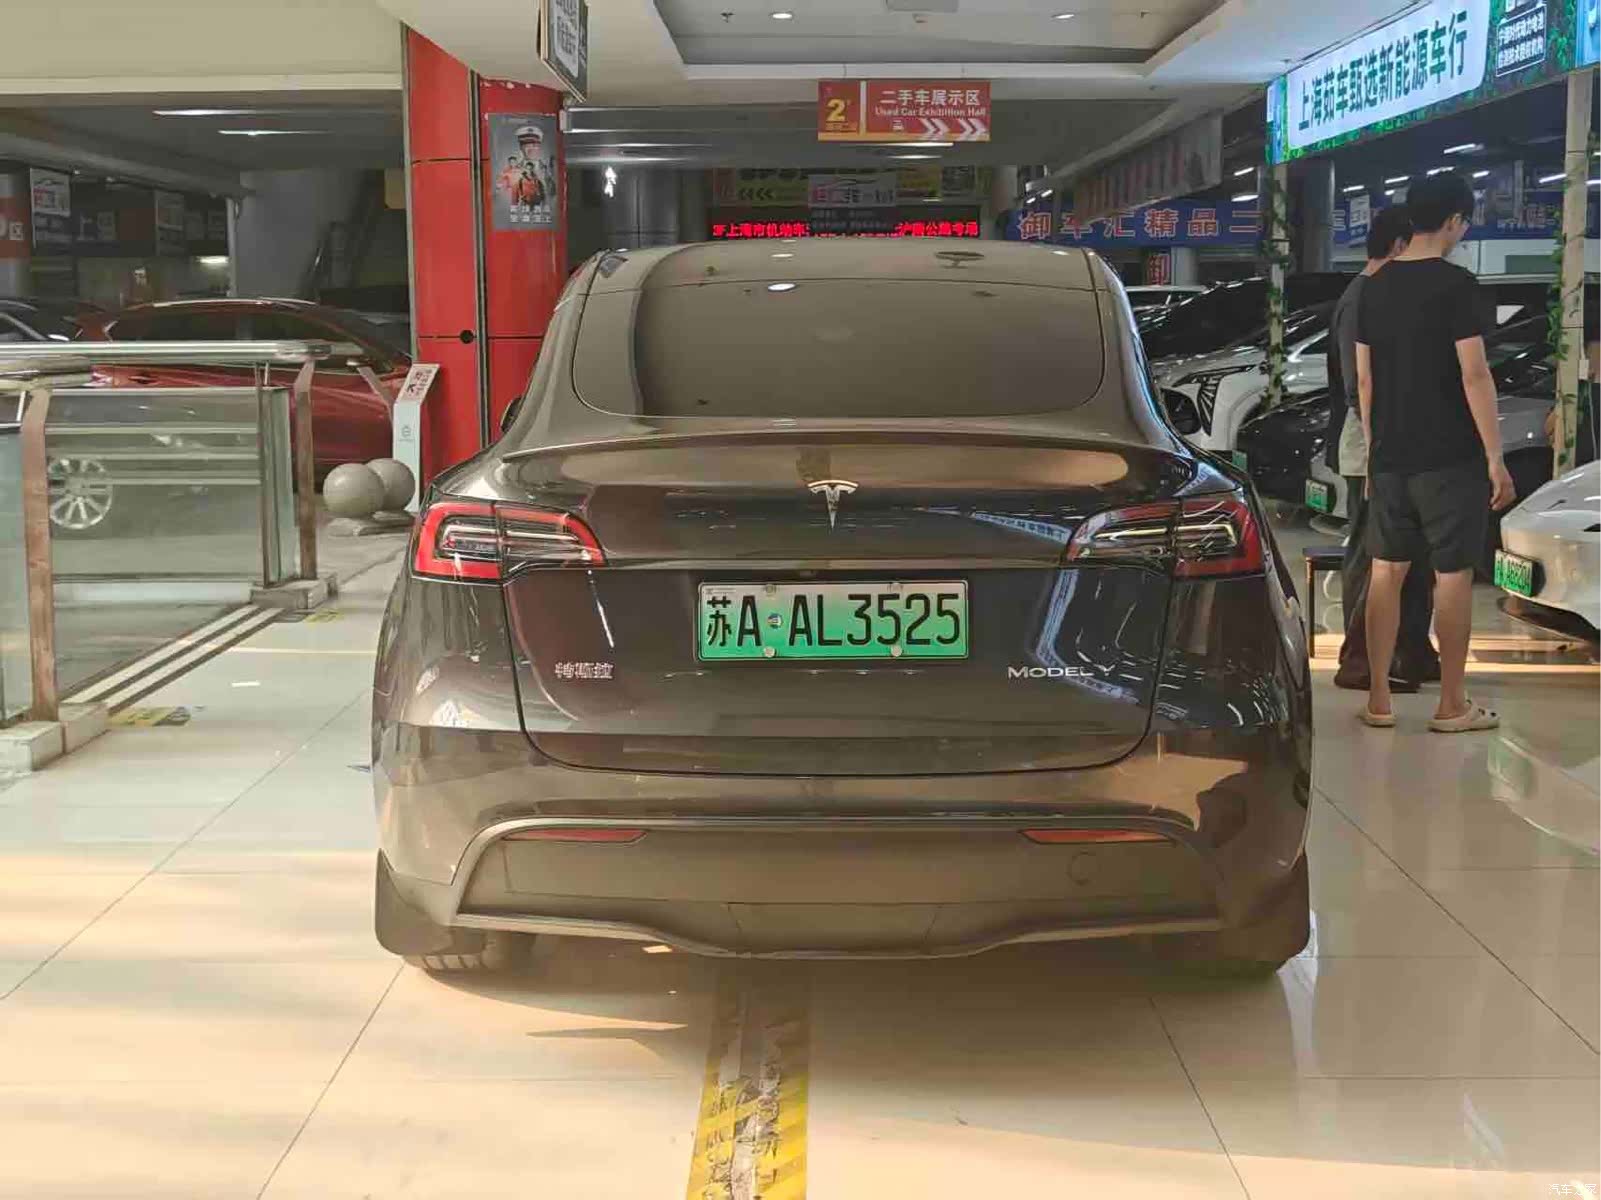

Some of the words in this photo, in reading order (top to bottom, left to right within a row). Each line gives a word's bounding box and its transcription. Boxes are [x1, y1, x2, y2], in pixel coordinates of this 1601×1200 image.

[879, 89, 981, 106] 二手车展示区
[875, 106, 898, 116] Used
[901, 106, 917, 116] Car
[919, 106, 966, 117] Exhibition
[968, 106, 986, 117] Hall
[706, 594, 762, 647] 苏A
[788, 593, 961, 646] AL3525
[555, 662, 614, 679] 特斯拉
[1007, 666, 1095, 678] MODEL
[1094, 664, 1116, 677] Y
